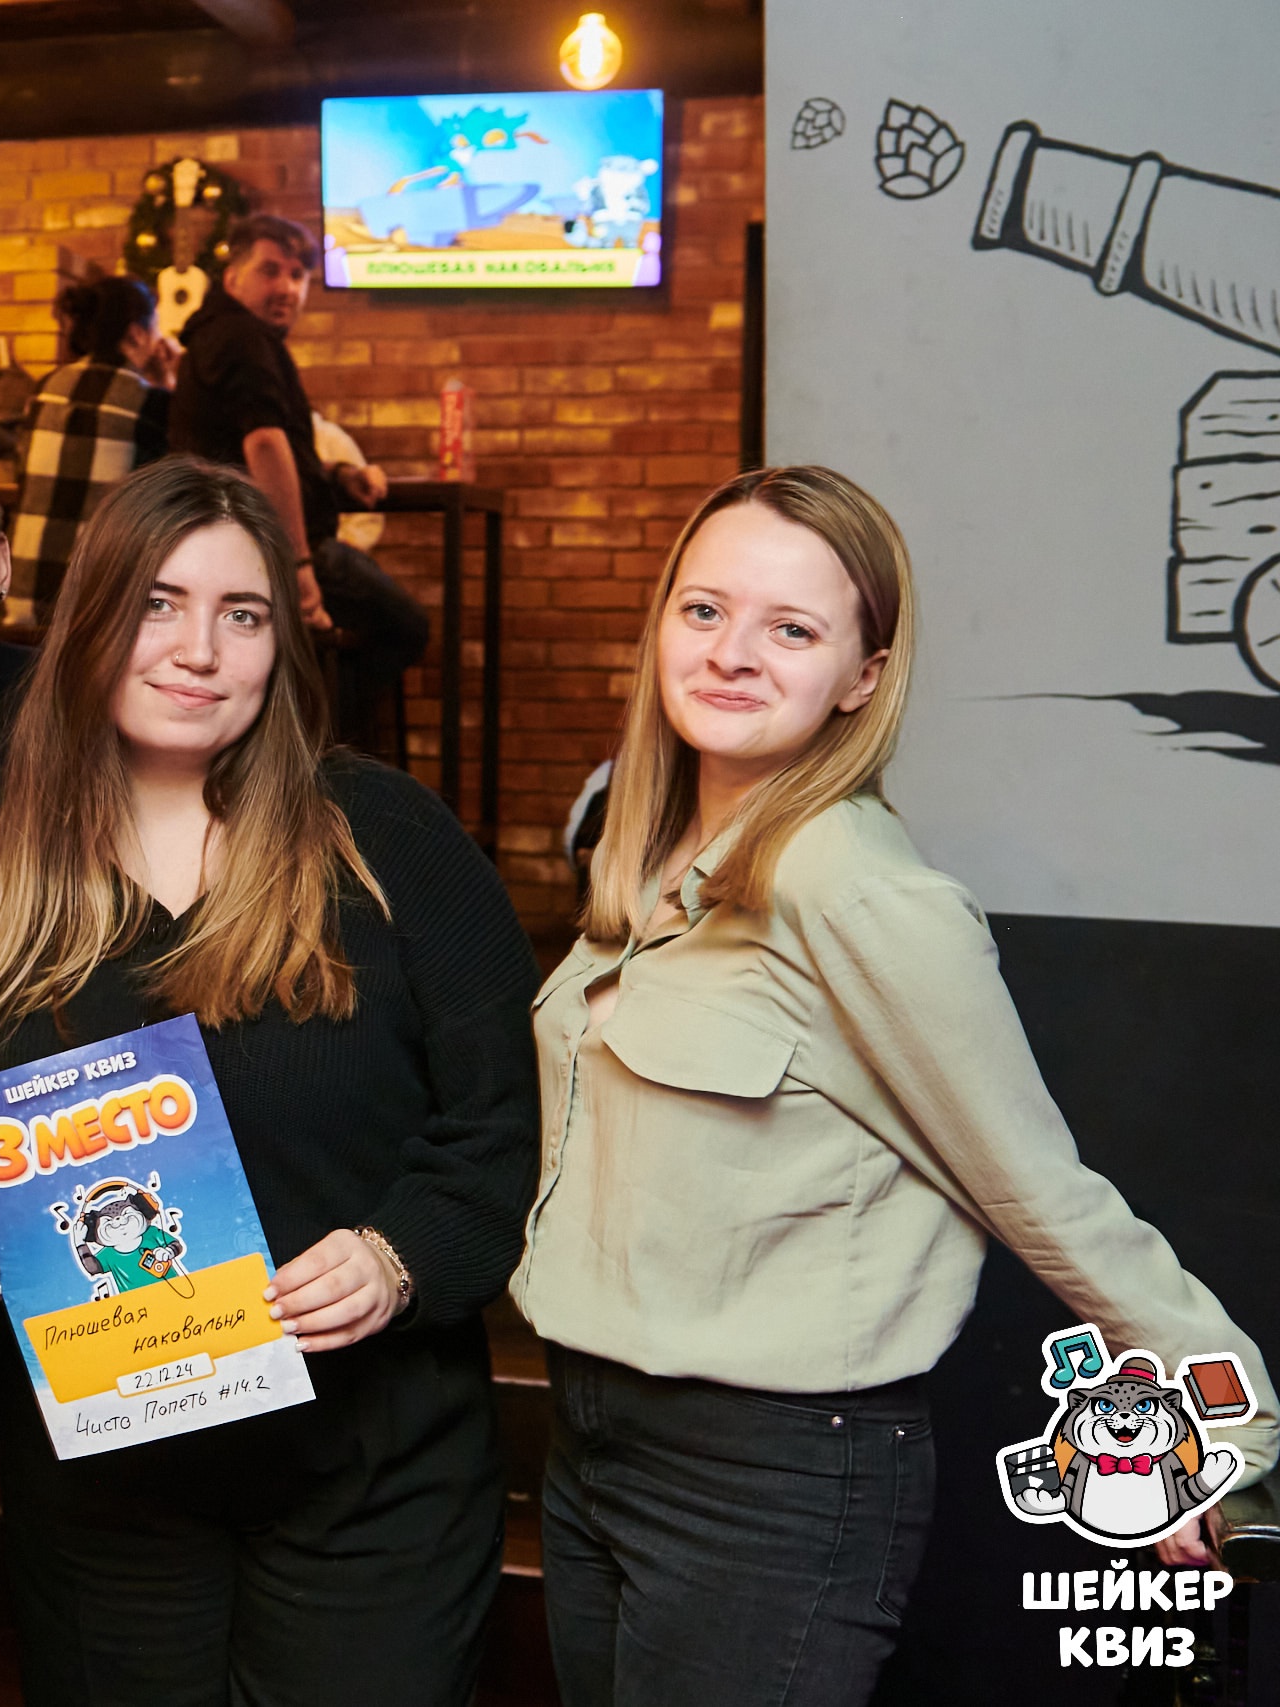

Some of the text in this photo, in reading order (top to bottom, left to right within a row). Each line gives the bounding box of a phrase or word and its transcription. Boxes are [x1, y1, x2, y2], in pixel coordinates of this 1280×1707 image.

[3, 1051, 137, 1104] ШЕЙКЕР КВИЗ
[34, 1080, 191, 1169] МЕСТО
[45, 1305, 148, 1350] Плюшевая
[133, 1309, 246, 1354] наковальня
[134, 1363, 194, 1389] 22.12.24
[76, 1412, 131, 1436] Чисто
[144, 1391, 208, 1424] Попеть
